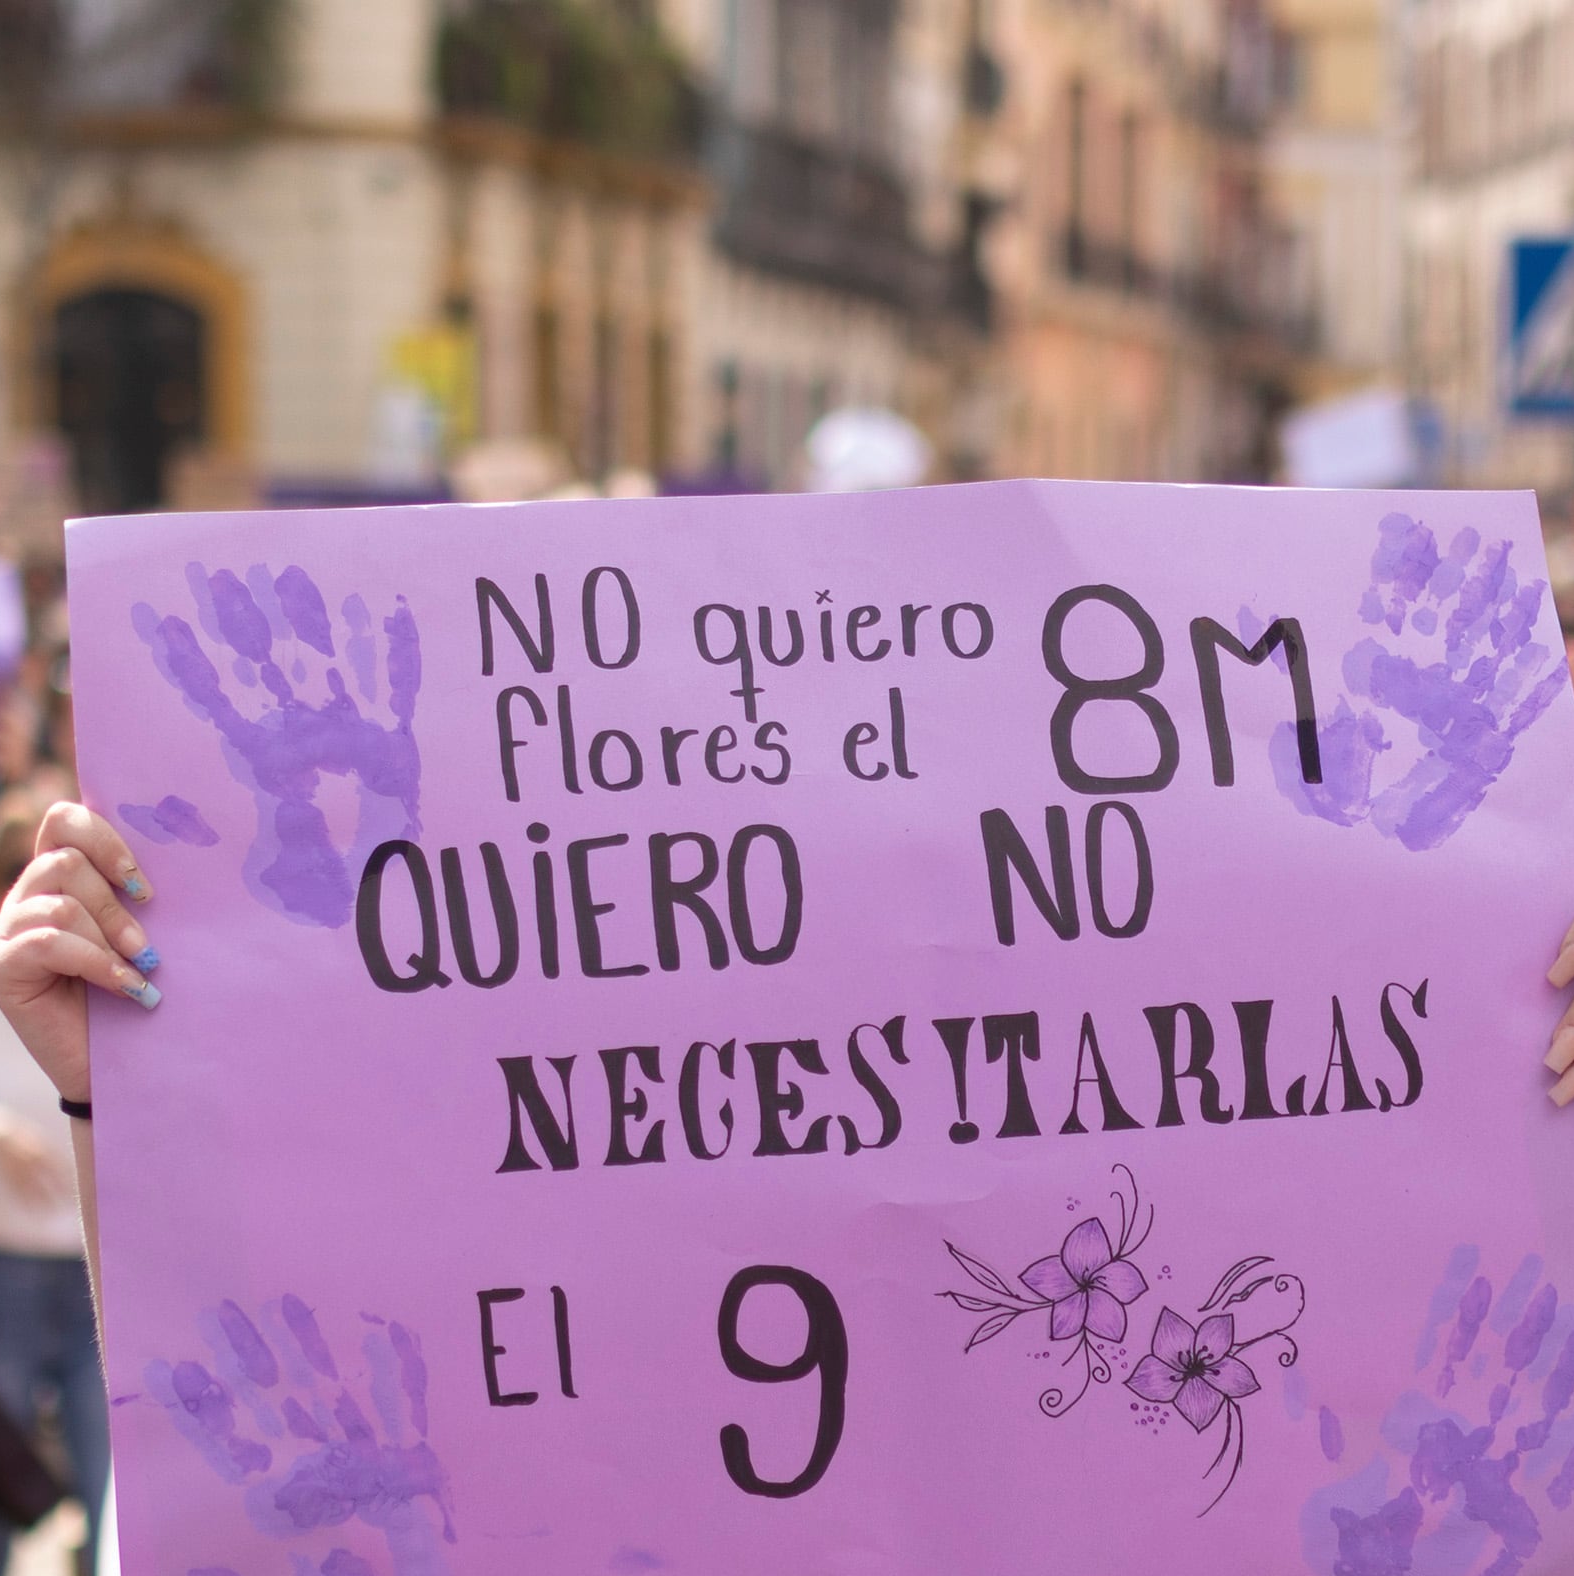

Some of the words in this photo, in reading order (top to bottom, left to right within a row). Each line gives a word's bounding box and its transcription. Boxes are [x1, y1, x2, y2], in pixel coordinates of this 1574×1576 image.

[474, 565, 642, 677] NO
[692, 587, 995, 724] quiero
[495, 684, 793, 804] flores
[842, 686, 920, 782] el
[1040, 582, 1324, 796] 8M
[979, 799, 1155, 948] NO
[716, 1263, 850, 1501] 9
